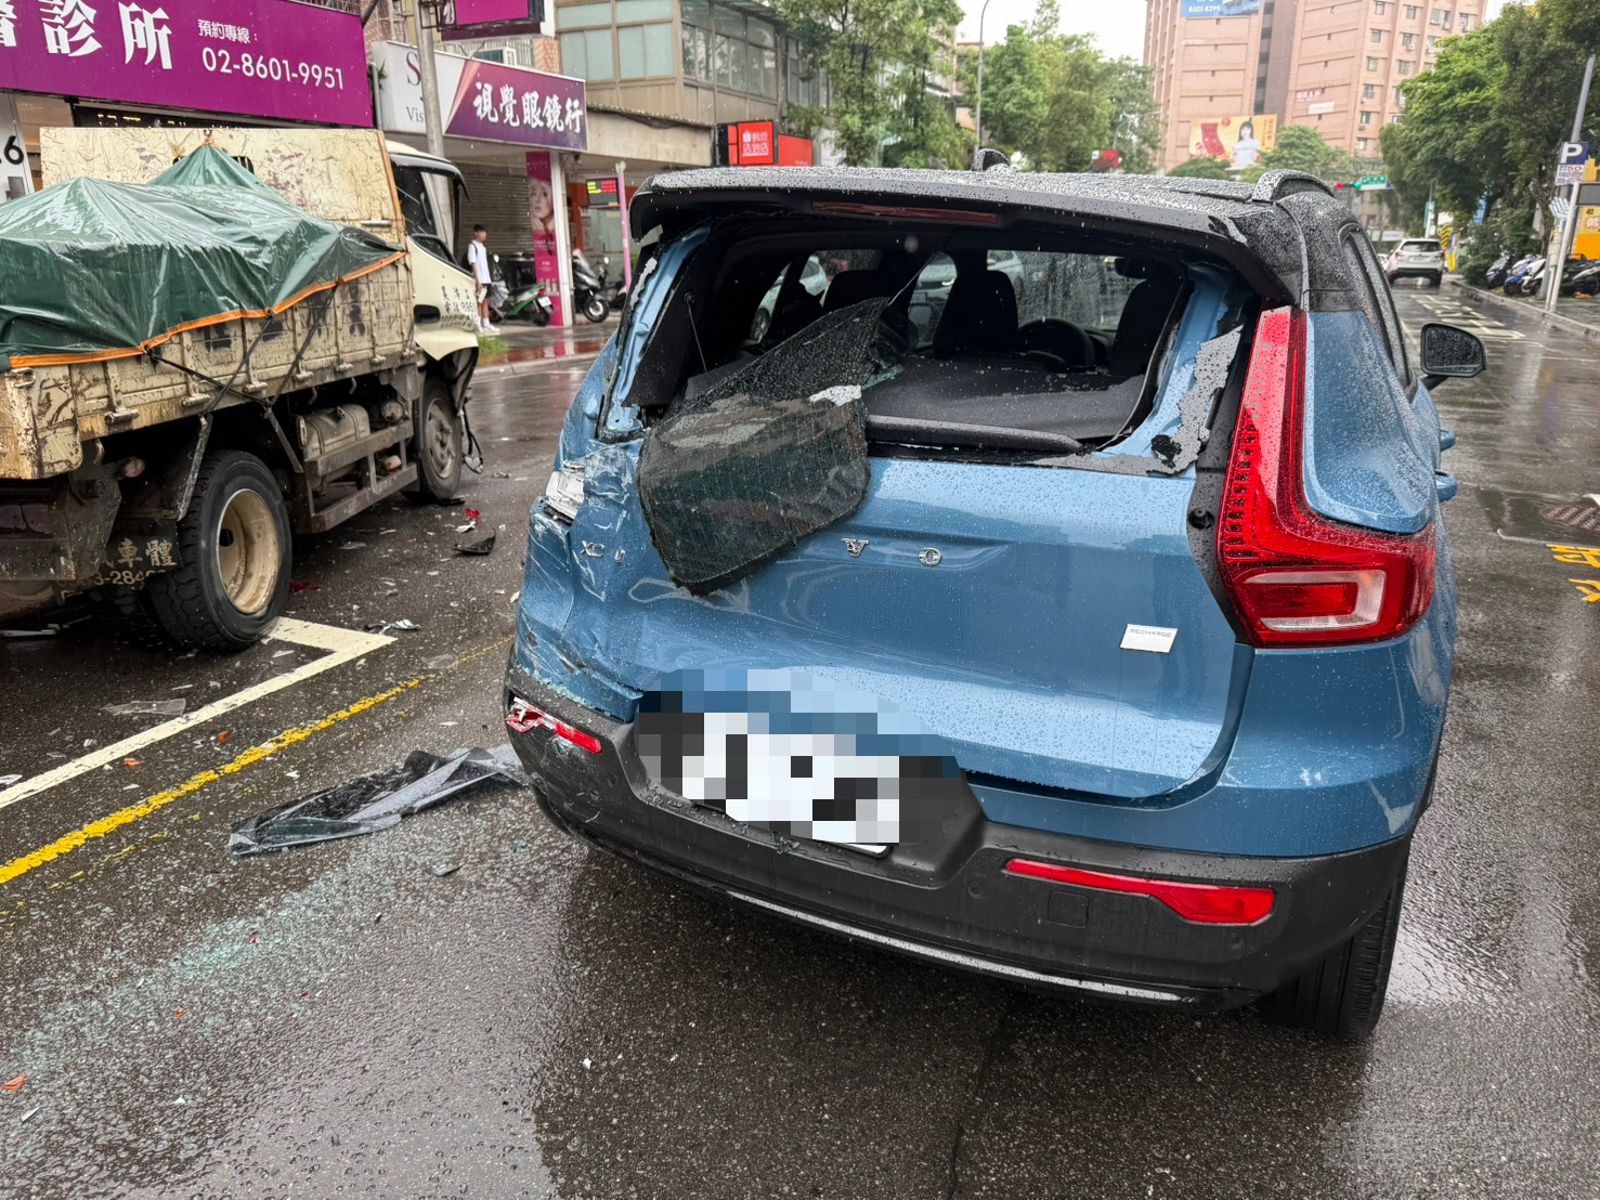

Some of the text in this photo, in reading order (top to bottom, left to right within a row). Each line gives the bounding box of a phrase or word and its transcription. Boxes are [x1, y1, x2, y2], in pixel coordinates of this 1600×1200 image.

[0, 0, 173, 70] 診所
[202, 47, 344, 90] 02-8601-9951
[406, 106, 425, 123] Vis
[473, 81, 584, 133] 視覺眼鏡行
[0, 134, 25, 166] 6
[1560, 142, 1583, 163] P
[104, 537, 178, 569] 車體
